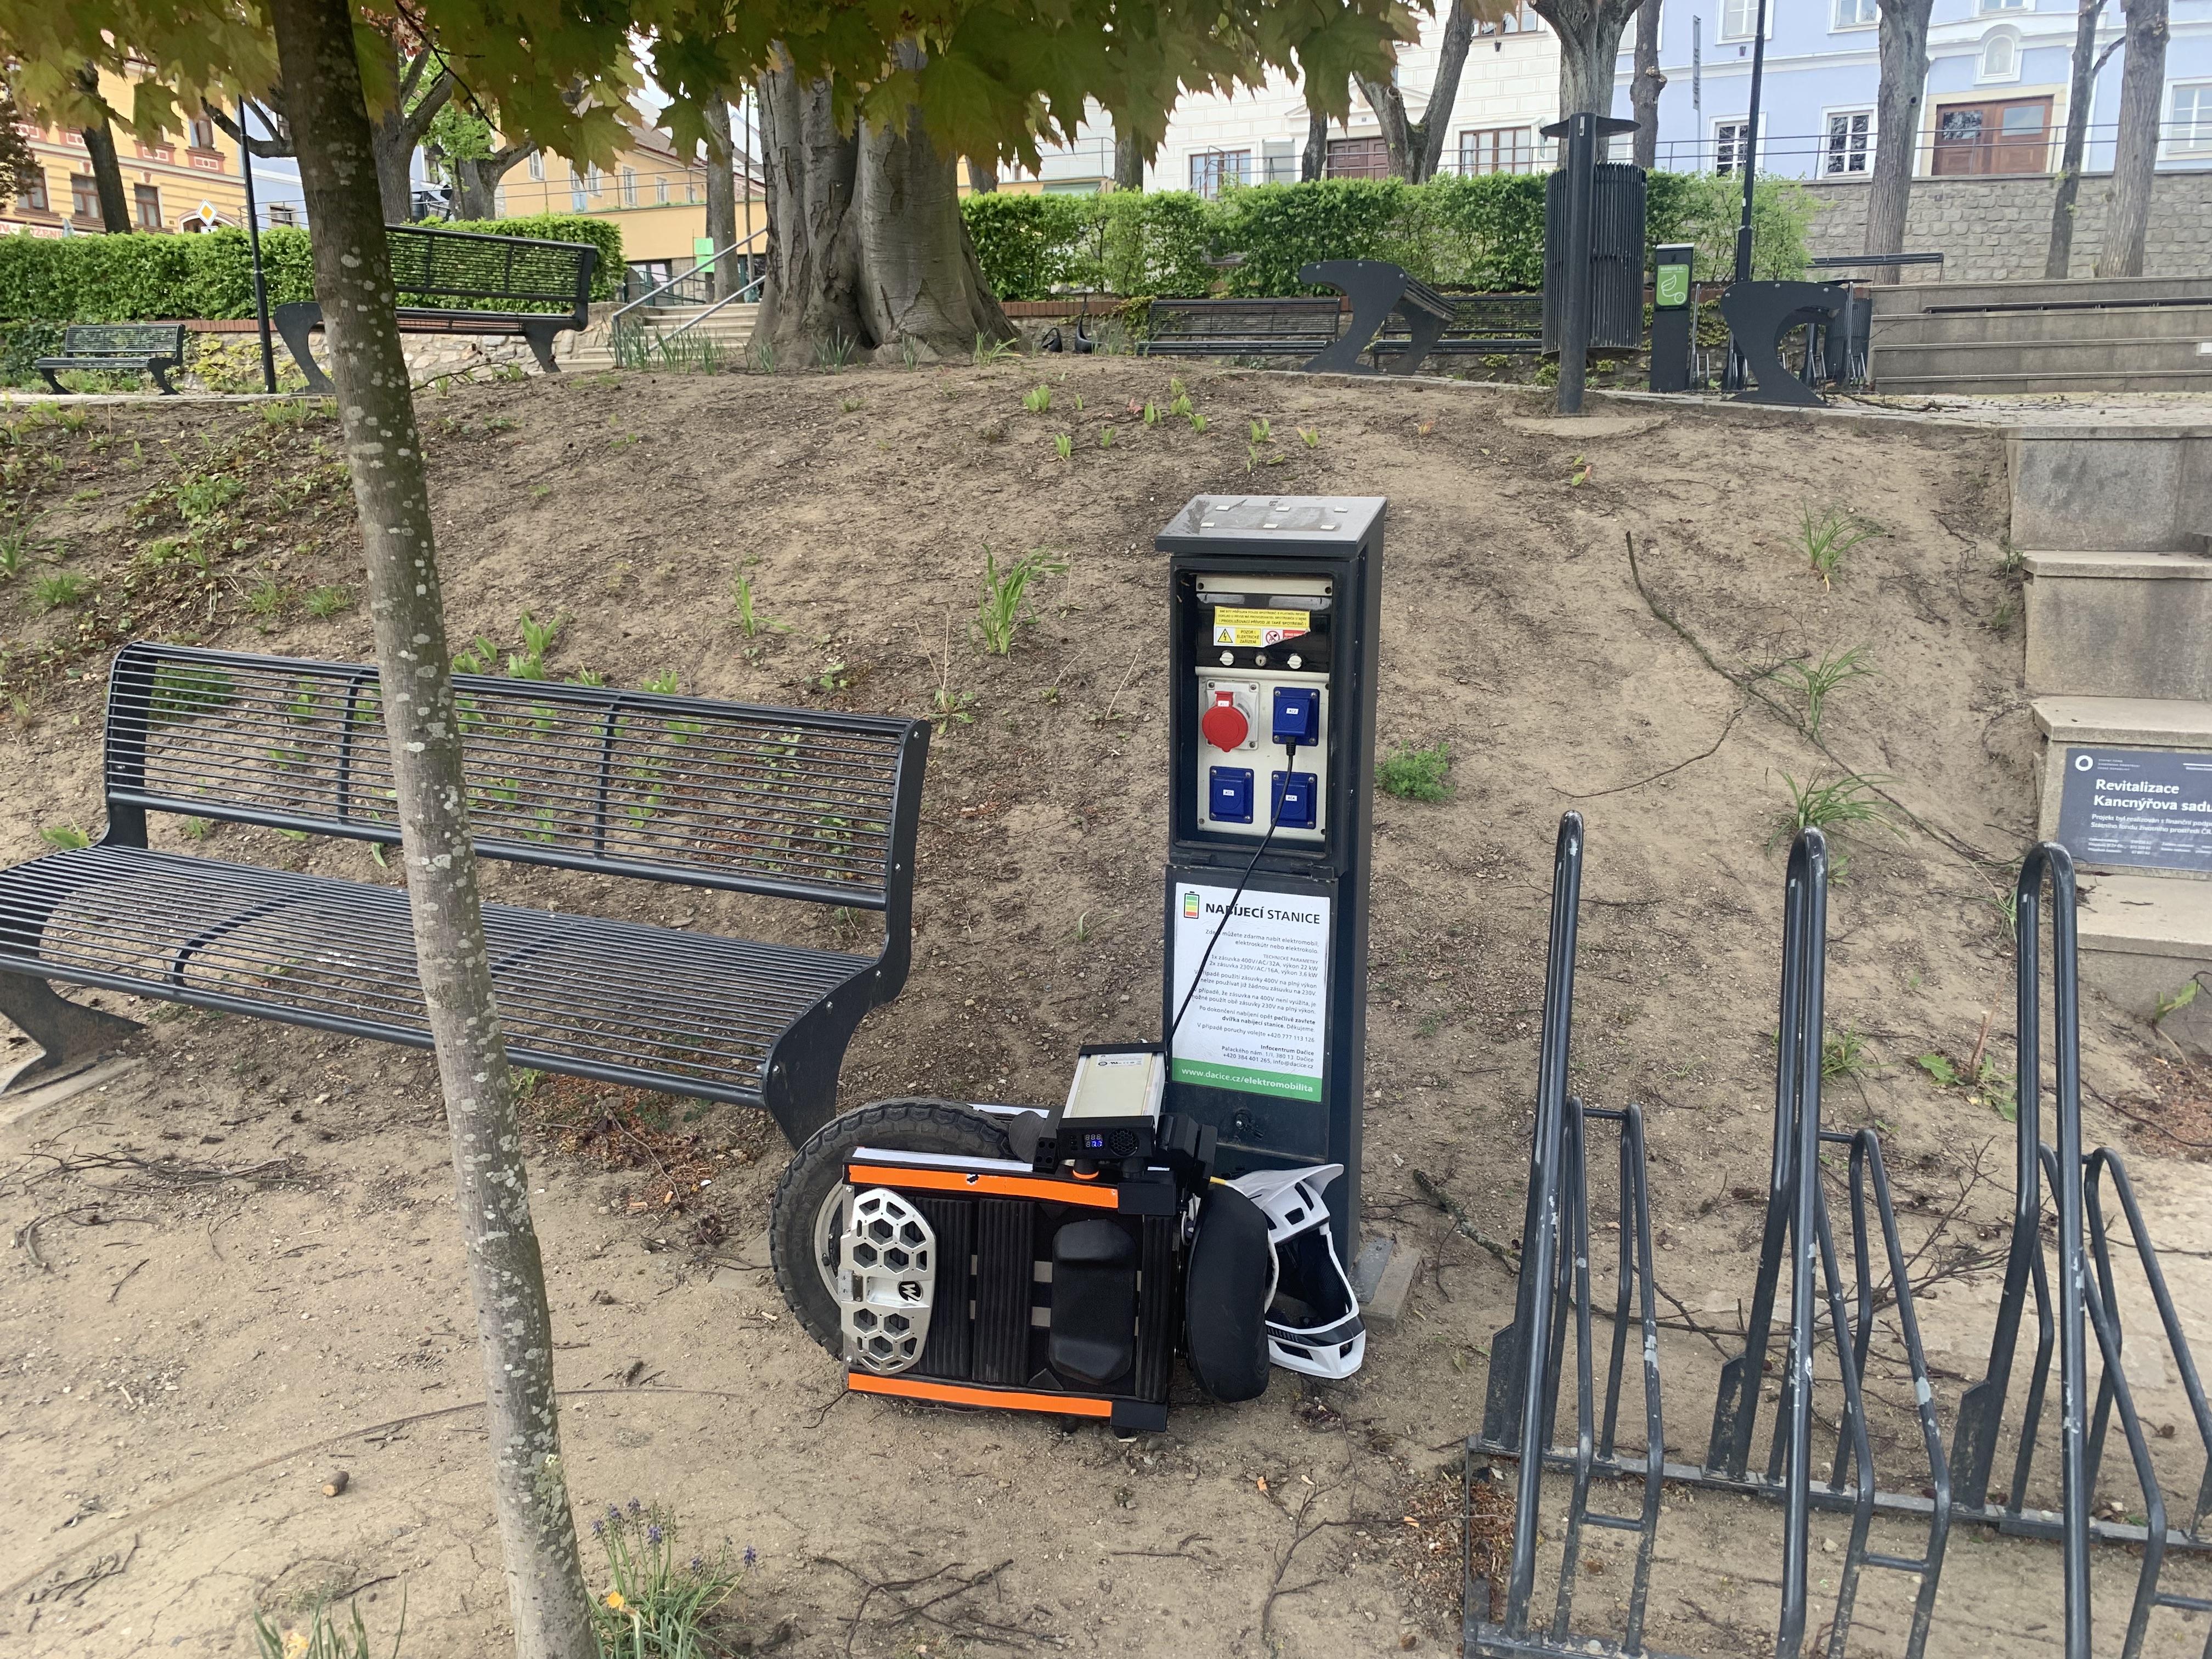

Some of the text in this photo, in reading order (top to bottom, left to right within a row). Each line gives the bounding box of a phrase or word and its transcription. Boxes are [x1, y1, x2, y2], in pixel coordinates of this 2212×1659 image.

[2096, 778, 2180, 794] Revitalizace
[2094, 795, 2177, 811] Kancnýřova
[1206, 903, 1320, 924] NABÍJECÍ STANICE
[1207, 1006, 1235, 1015] dokončení
[1222, 1045, 1249, 1054] Palackého
[1261, 1045, 1295, 1054] Infocentrum
[1182, 1068, 1313, 1092] www.dacice.cz/elektromobilita
